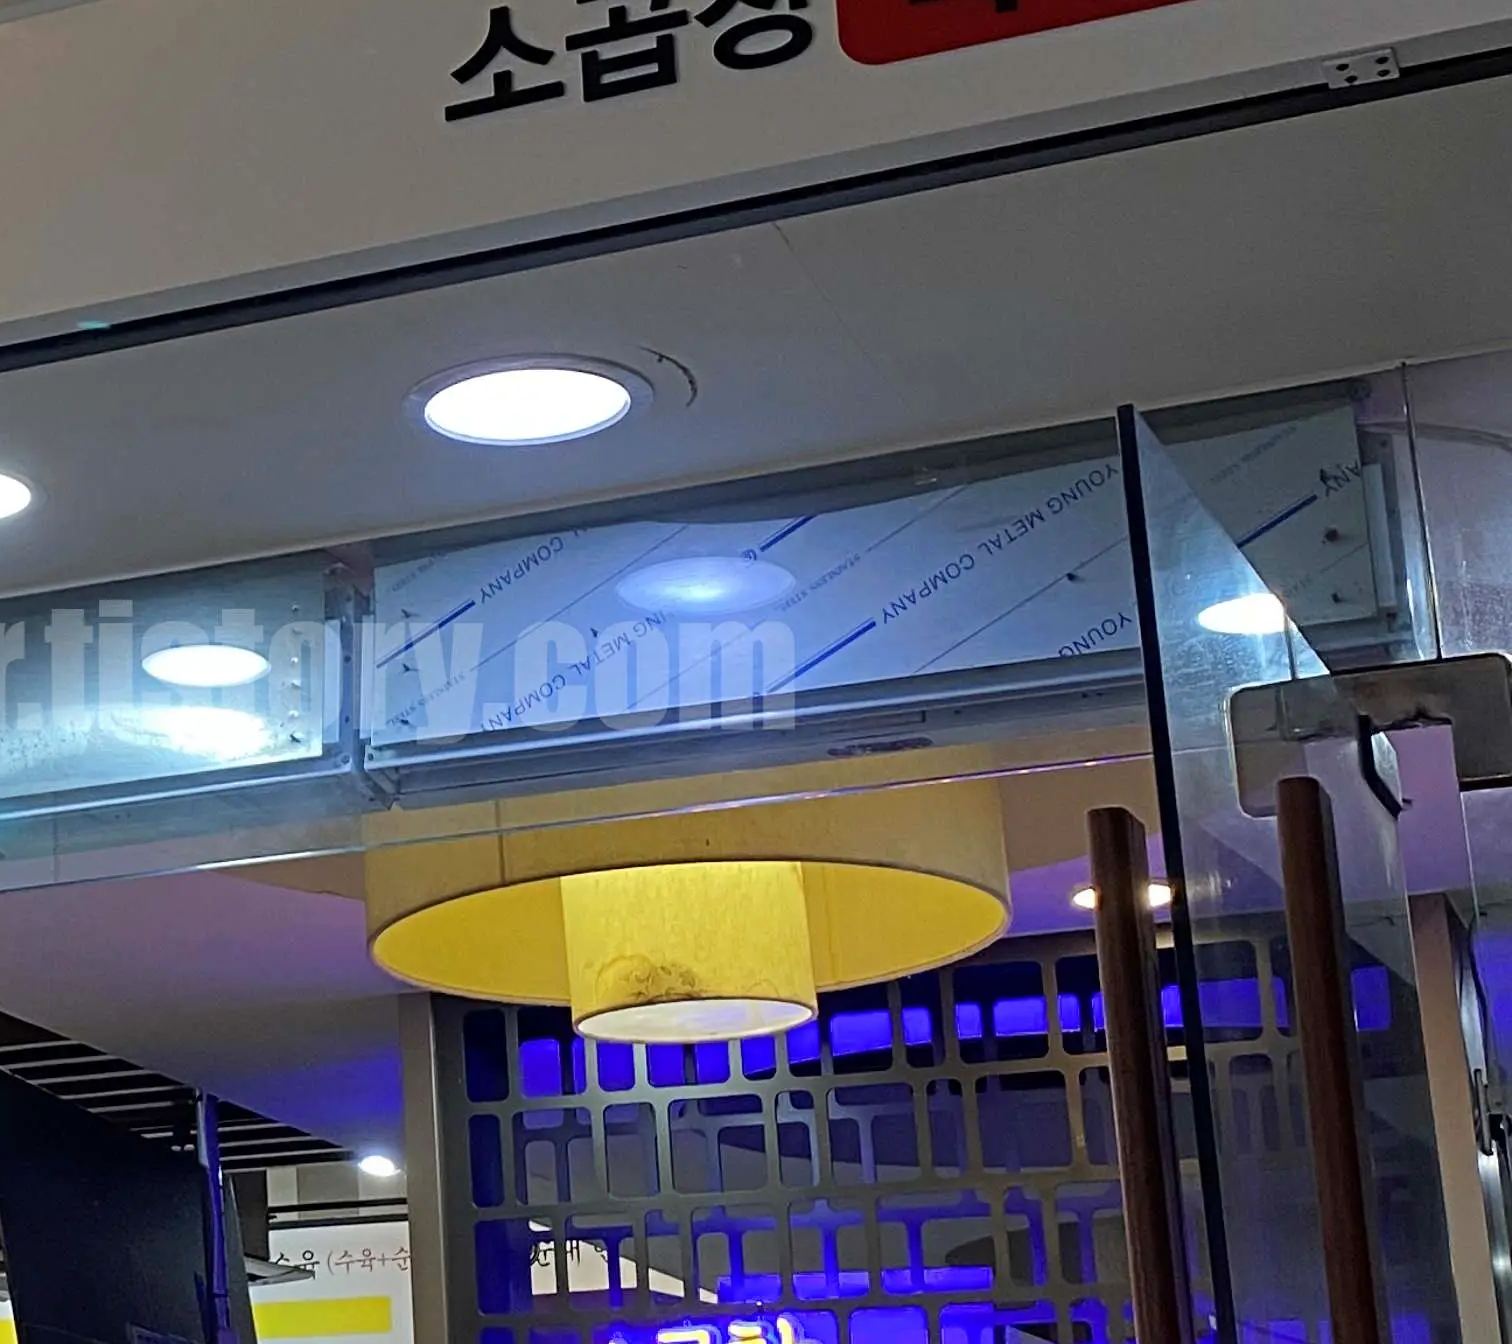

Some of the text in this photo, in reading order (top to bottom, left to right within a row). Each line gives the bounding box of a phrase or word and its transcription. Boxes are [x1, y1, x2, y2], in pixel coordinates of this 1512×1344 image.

[481, 536, 564, 605] COMPANY
[883, 463, 1120, 624] YOUNG METAL COMPANY
